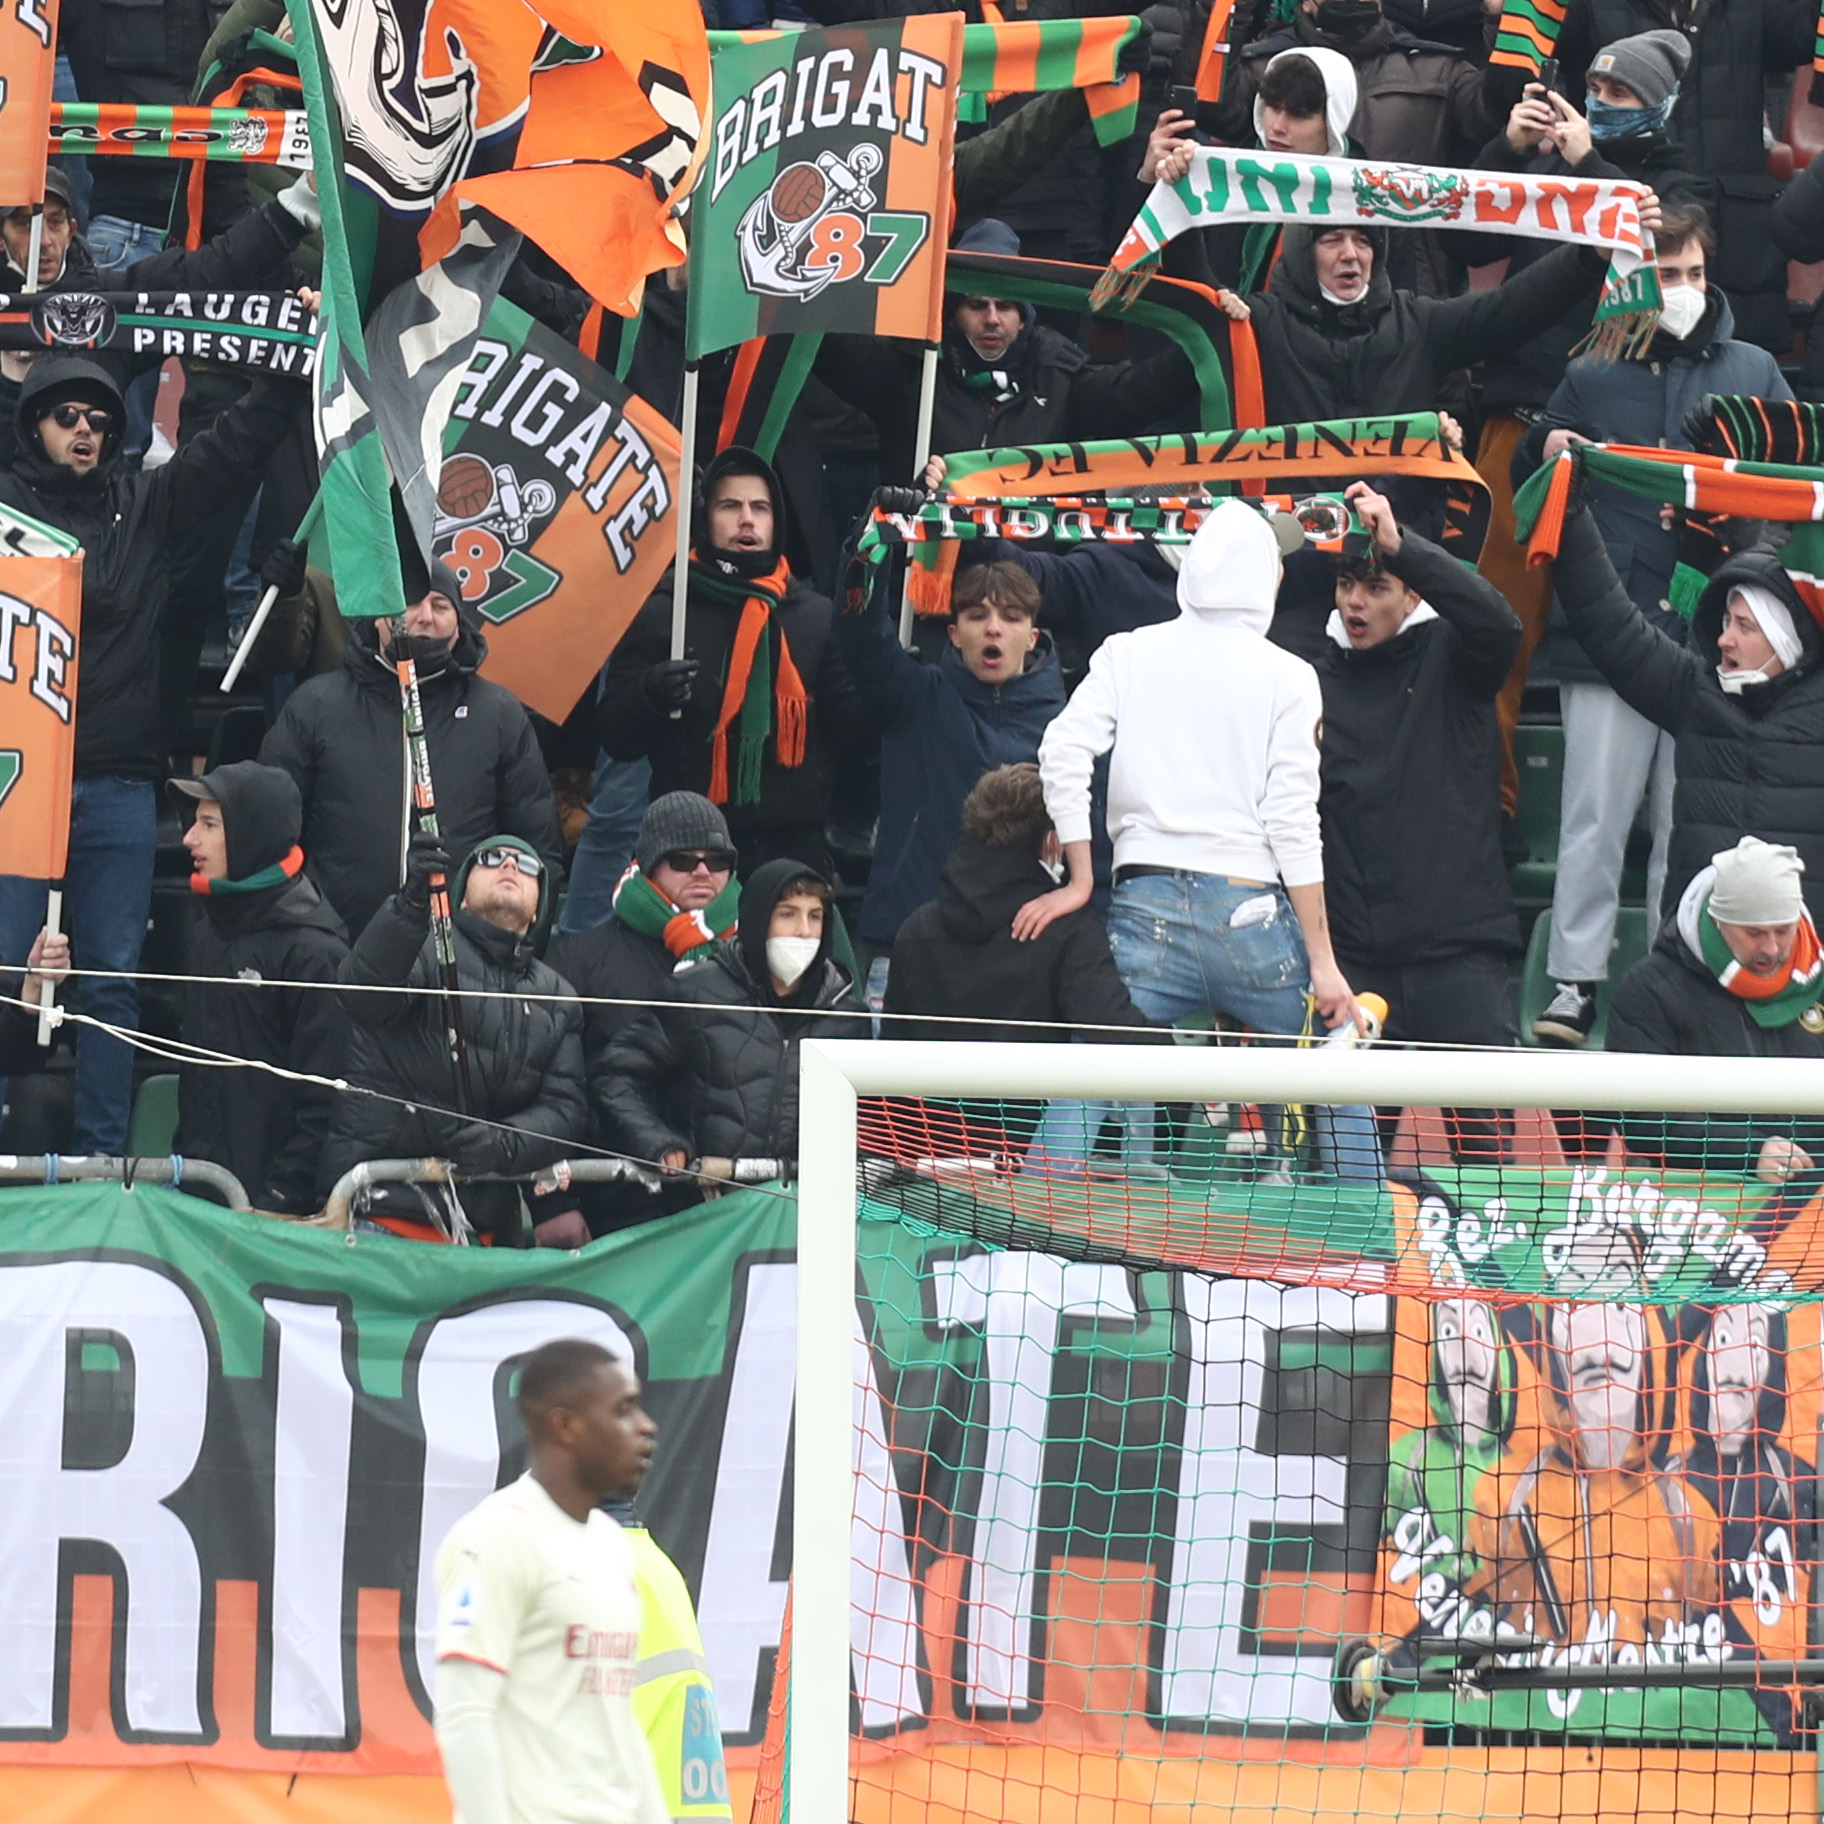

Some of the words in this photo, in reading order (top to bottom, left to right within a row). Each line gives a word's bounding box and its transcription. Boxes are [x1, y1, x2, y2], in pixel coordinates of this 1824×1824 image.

[806, 209, 930, 283] 87
[455, 339, 675, 573] RIGATE
[988, 441, 1089, 484] FC
[1121, 419, 1456, 469] VENEZIA
[453, 526, 563, 626] 87
